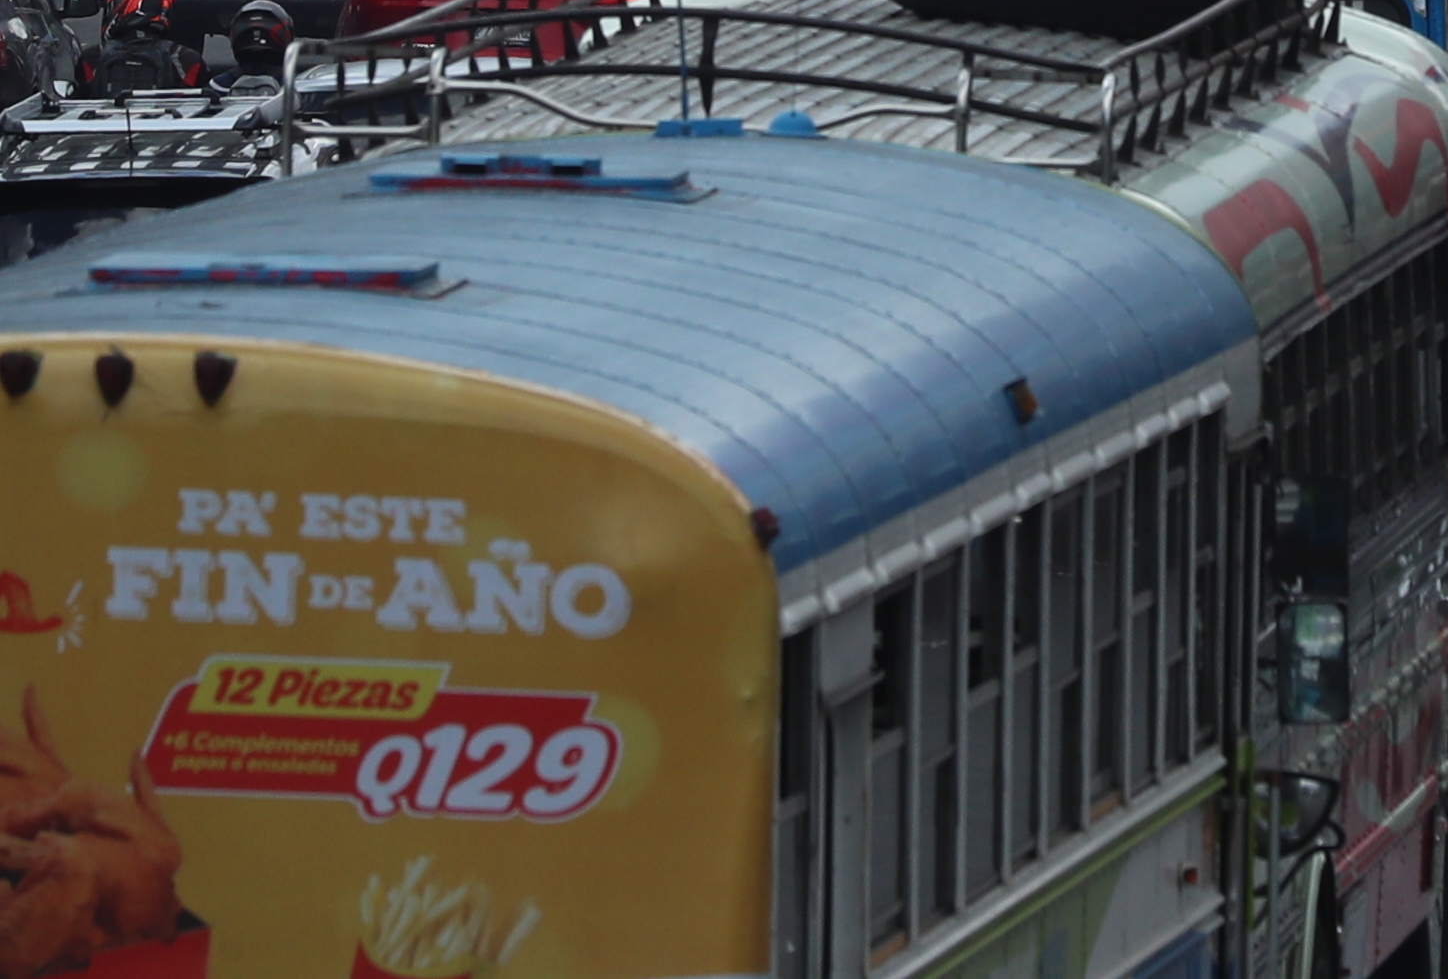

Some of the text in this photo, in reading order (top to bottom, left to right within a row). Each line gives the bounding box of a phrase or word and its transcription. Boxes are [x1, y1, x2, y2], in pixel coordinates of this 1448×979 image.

[298, 492, 467, 545] ESTE
[104, 537, 633, 640] FIN DE AÑO
[213, 667, 419, 711] 12 Piezas
[192, 730, 361, 758] Complementos
[355, 722, 613, 815] Q129
